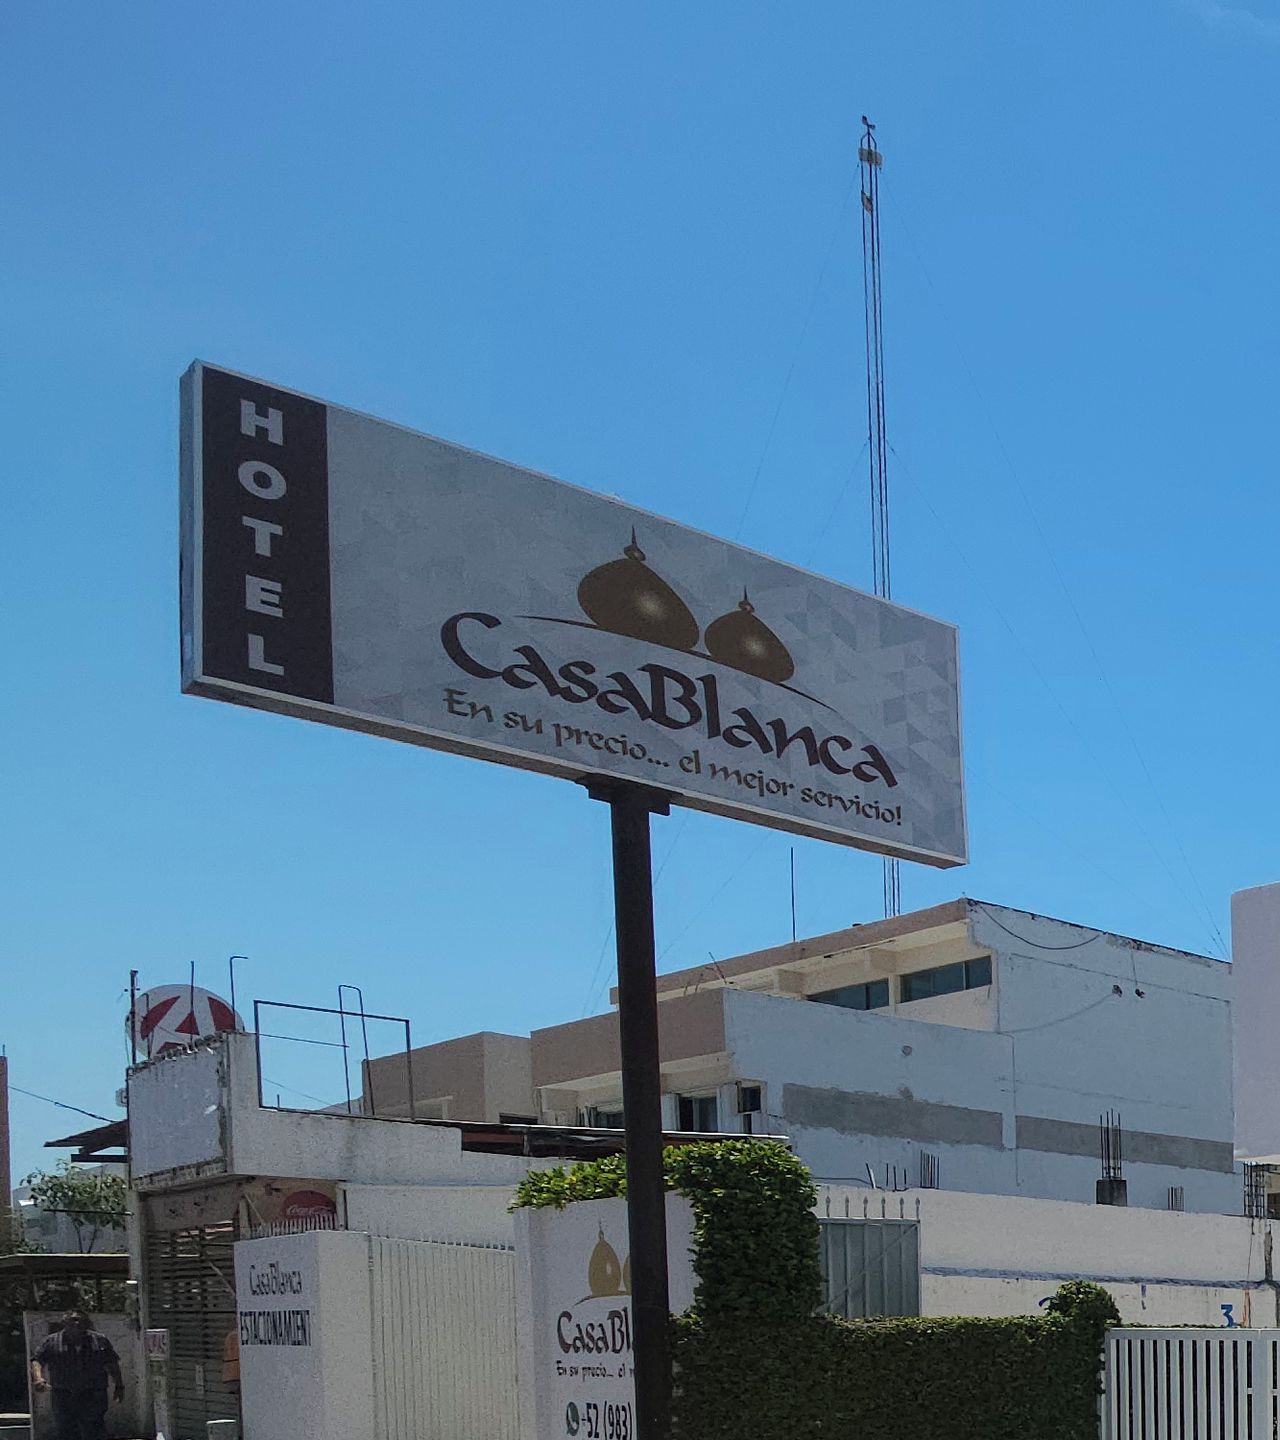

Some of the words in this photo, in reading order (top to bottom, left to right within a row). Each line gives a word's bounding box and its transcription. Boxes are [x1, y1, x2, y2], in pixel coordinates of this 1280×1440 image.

[238, 399, 287, 677] HOTEL
[440, 611, 898, 788] CasaBlanca
[442, 688, 493, 723] En
[503, 710, 543, 735] su
[553, 721, 670, 769] precio...
[679, 749, 701, 775] el
[708, 762, 794, 797] mejor
[800, 785, 902, 827] servicio!
[557, 1306, 633, 1354] CasaBl
